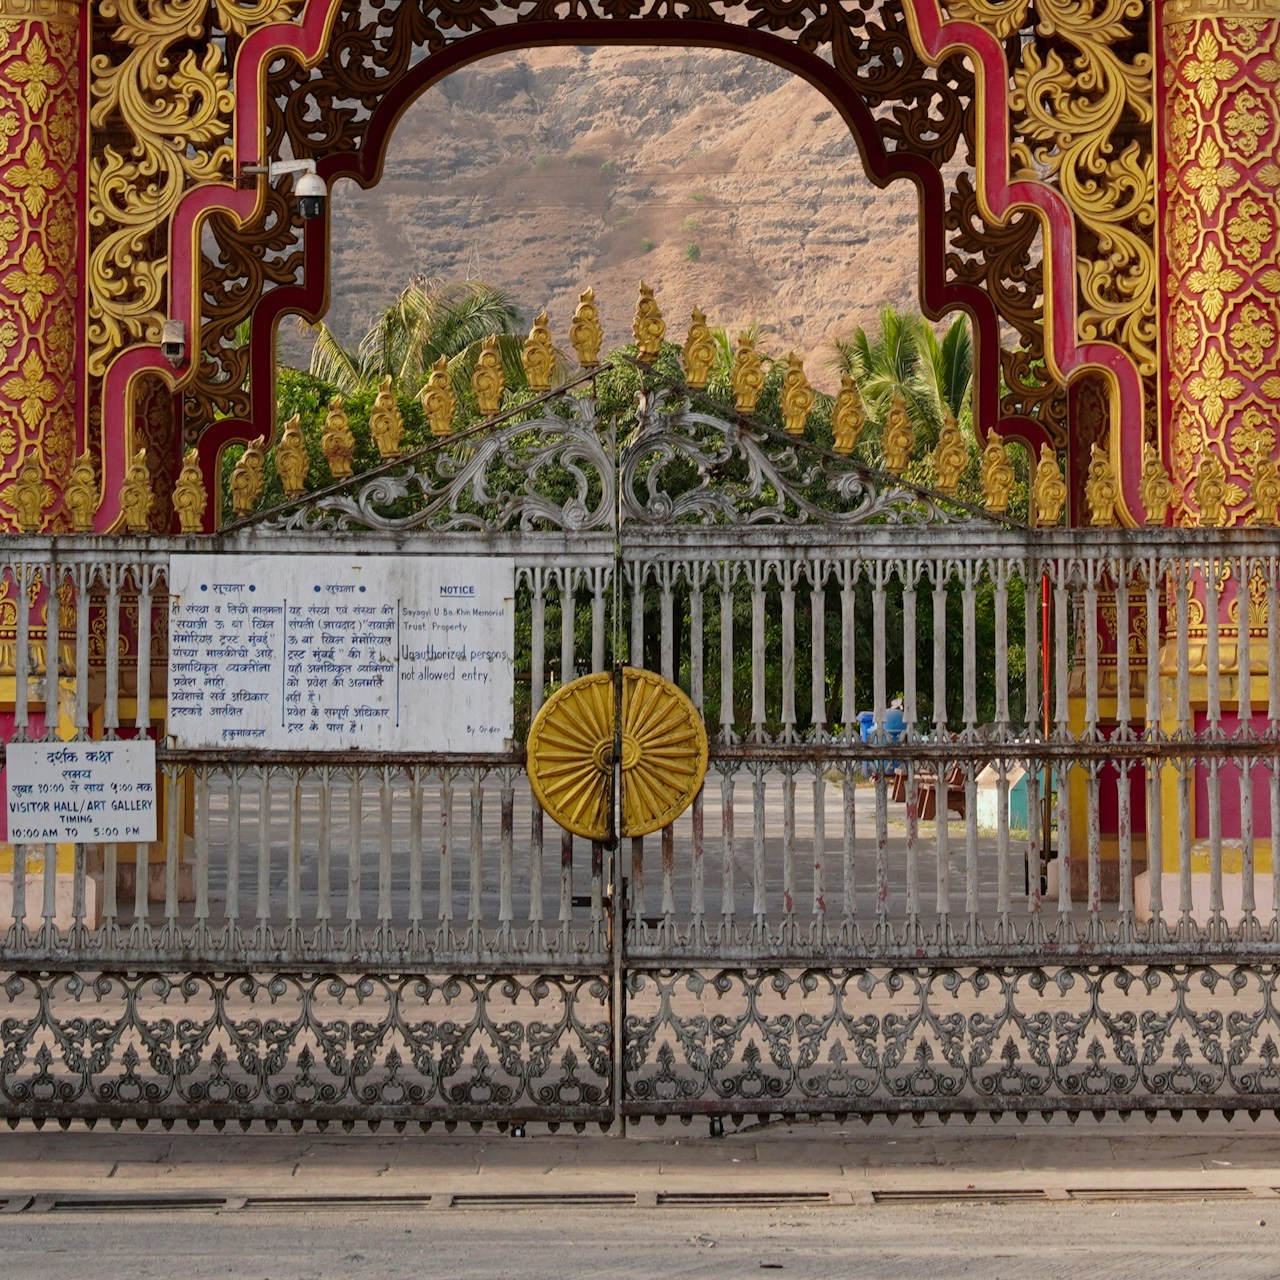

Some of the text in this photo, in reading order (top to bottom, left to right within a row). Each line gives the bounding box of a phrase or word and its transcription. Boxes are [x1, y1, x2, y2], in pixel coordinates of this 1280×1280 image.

[213, 584, 245, 594] सूचना
[326, 585, 356, 595] सूचना
[440, 586, 475, 595] NOTICE
[172, 602, 180, 616] ही
[186, 604, 209, 615] संस्था
[215, 606, 221, 614] व
[228, 603, 248, 615] तिची
[289, 603, 394, 616] यह संस्था एवं संस्था की
[434, 608, 440, 616] U
[404, 622, 468, 633] Trust Property
[173, 633, 213, 645] मेमोरियल
[220, 635, 239, 646] ट्रस्ट
[351, 633, 392, 646] मेमोरियल
[173, 647, 198, 658] यांच्या
[206, 646, 249, 658] मालकीची
[288, 650, 306, 661] ट्रस्ट
[348, 647, 361, 659] की
[401, 644, 466, 660] Unauthorized
[173, 676, 196, 687] प्रवेश
[287, 675, 299, 687] को
[307, 676, 327, 688] प्रवेश
[332, 676, 344, 687] की
[401, 666, 492, 684] not allowed entry.
[211, 690, 225, 702] सर्व
[231, 689, 270, 702] अधिकार
[287, 705, 306, 718] प्रवेश
[311, 705, 319, 717] के
[354, 705, 390, 718] अधिकार
[288, 723, 304, 734] ट्रस्ट
[309, 720, 319, 732] के
[466, 725, 501, 737] By Order
[47, 748, 114, 767] दर्शक कक्ष
[62, 770, 93, 779] समय
[12, 785, 33, 798] सुबह
[70, 781, 79, 793] से
[136, 783, 153, 793] तक
[10, 802, 50, 813] VISITOR
[111, 800, 153, 811] GALLERY
[60, 815, 93, 824] TIMING
[65, 828, 78, 837] TO
[94, 827, 119, 837] 5:00
[126, 826, 140, 835] PM
